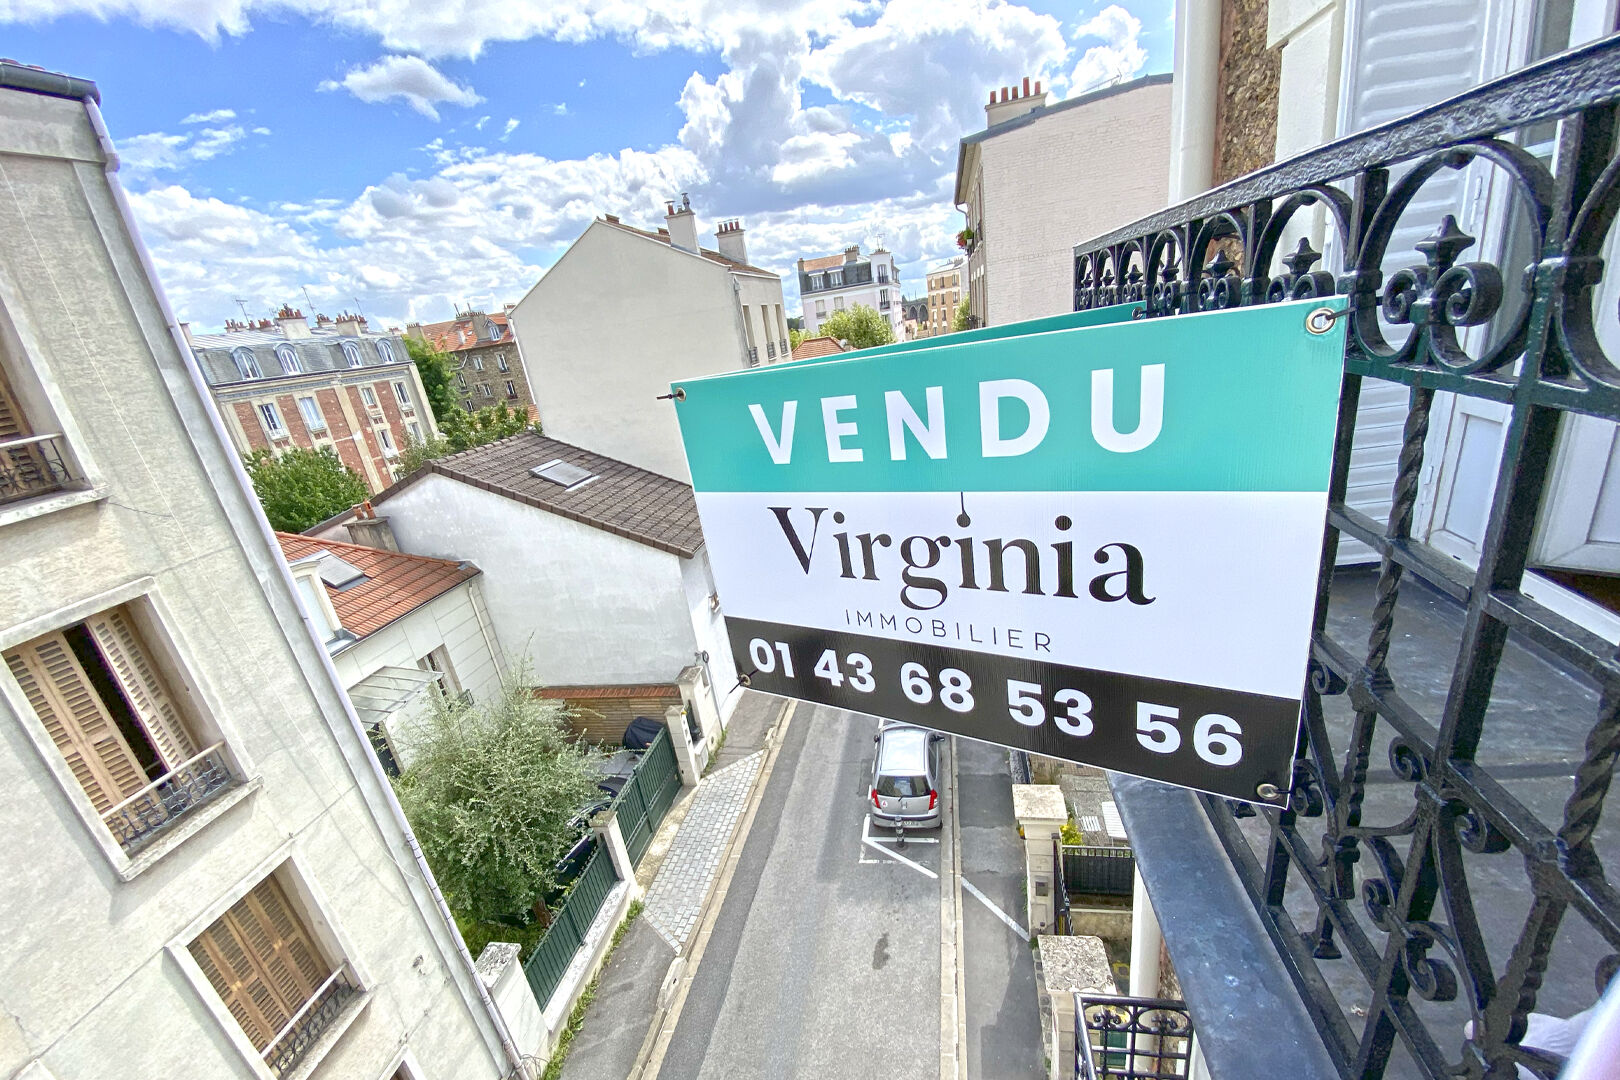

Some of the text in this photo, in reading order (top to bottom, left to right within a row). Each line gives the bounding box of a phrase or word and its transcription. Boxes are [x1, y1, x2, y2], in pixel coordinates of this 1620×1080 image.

[748, 363, 1166, 465] VENDU
[767, 492, 1157, 611] Virginia
[845, 609, 1053, 653] IMMOBILIER
[749, 637, 1243, 766] 01 43 68 53 56
